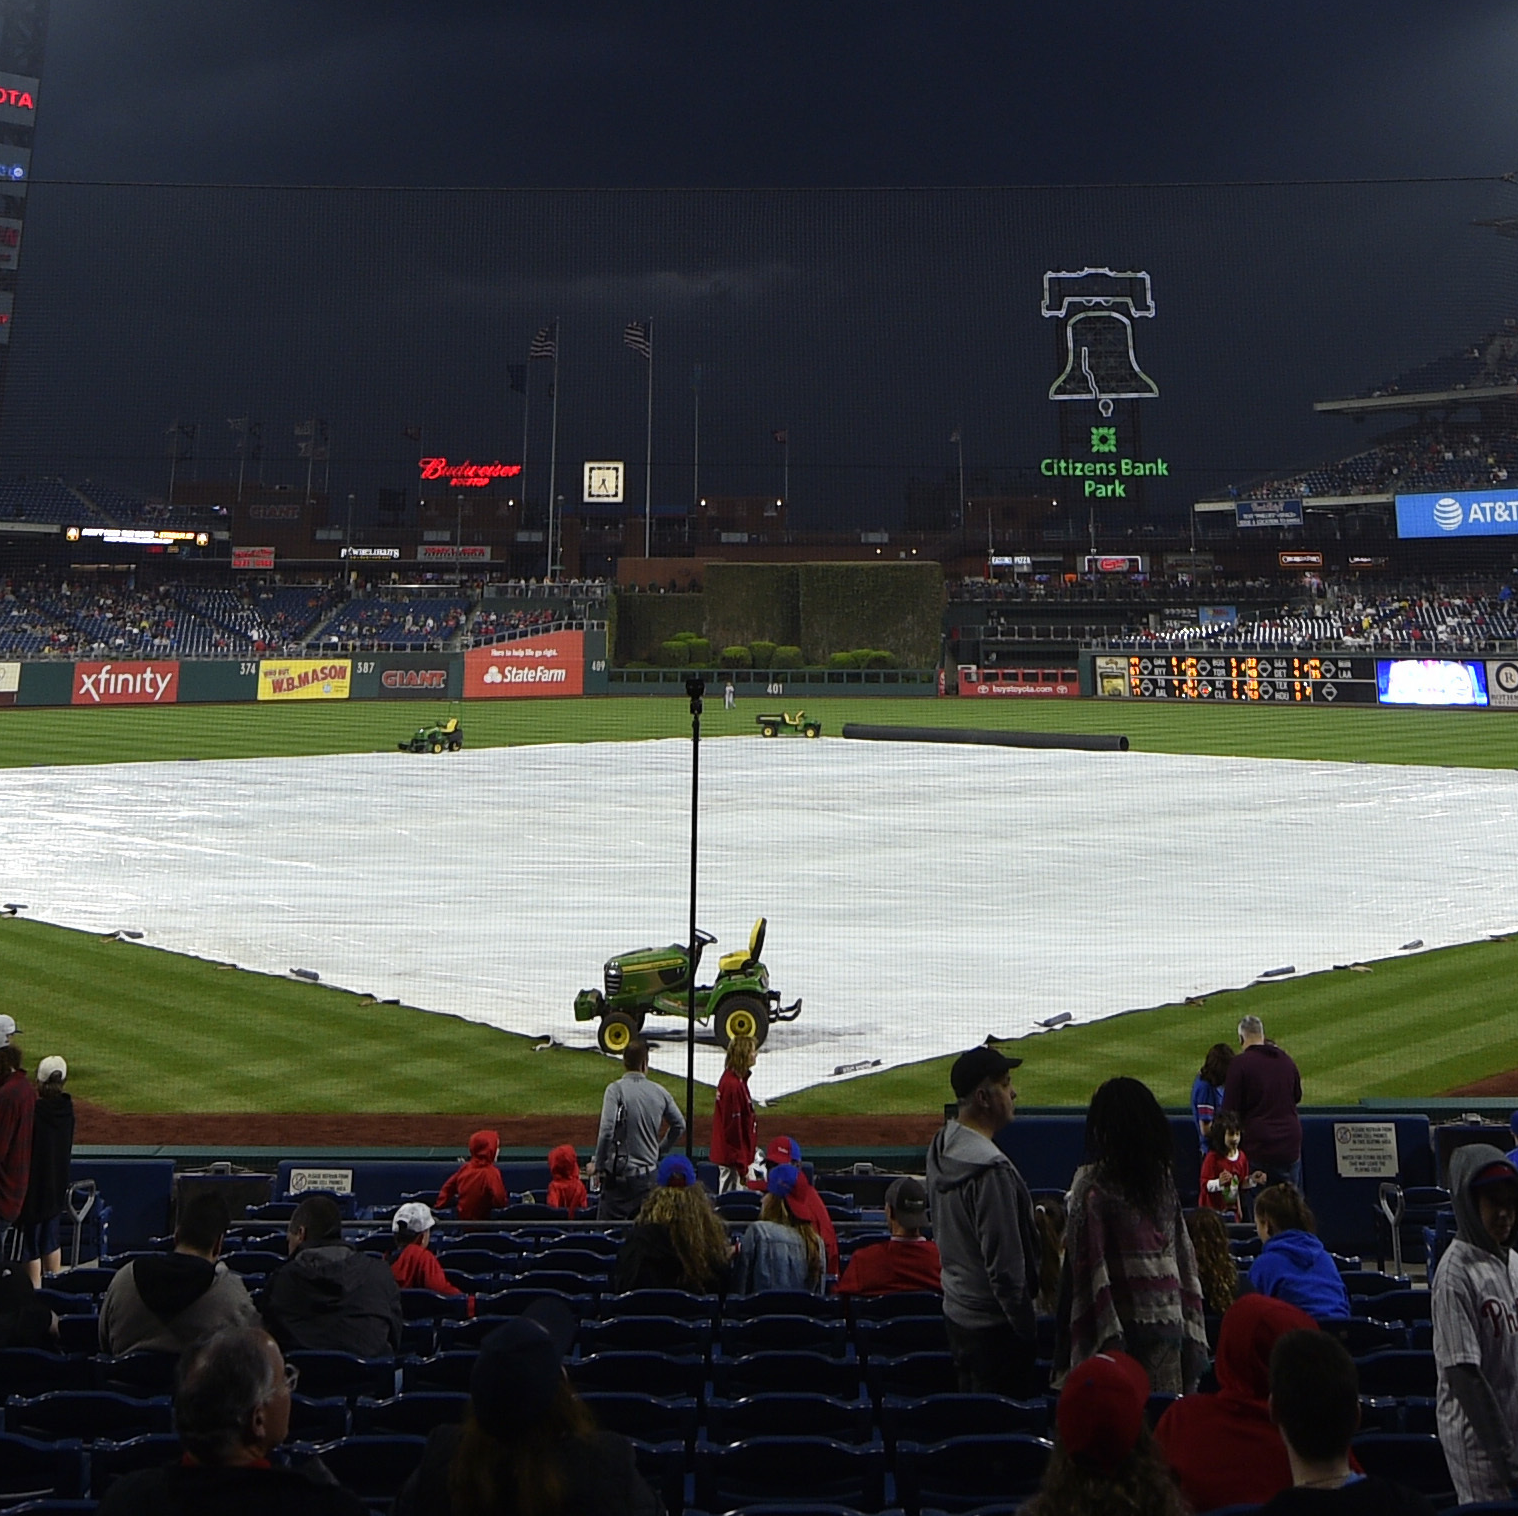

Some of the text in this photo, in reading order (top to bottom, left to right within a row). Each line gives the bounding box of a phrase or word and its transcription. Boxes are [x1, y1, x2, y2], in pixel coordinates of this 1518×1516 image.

[418, 457, 521, 481] Budweiser
[1040, 458, 1170, 477] Citizens Bank
[1084, 479, 1127, 498] Park
[240, 662, 256, 676] 374
[356, 662, 375, 675] 387
[591, 660, 607, 673] 409
[1338, 670, 1352, 678] LAA
[79, 666, 173, 701] xfinity
[381, 670, 447, 689] GIANT
[1503, 671, 1517, 685] R
